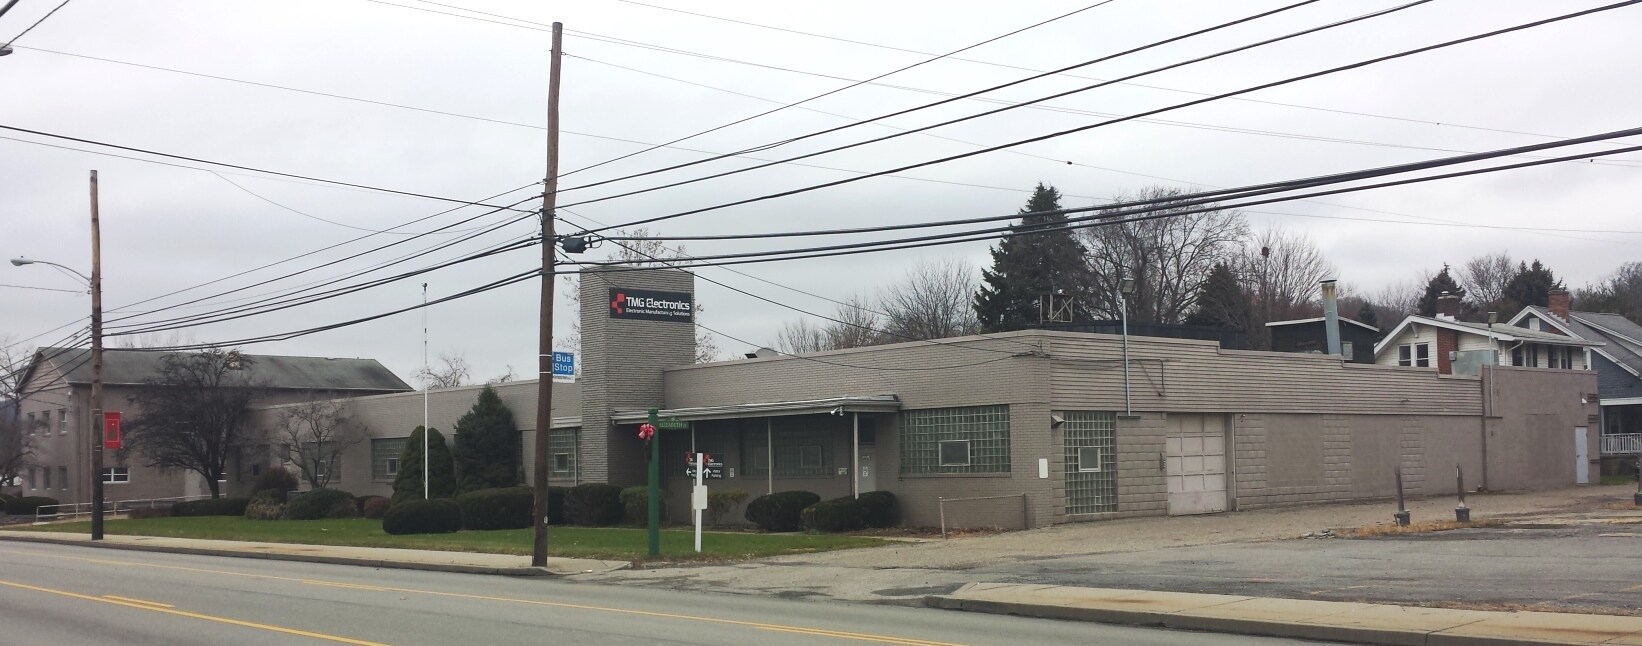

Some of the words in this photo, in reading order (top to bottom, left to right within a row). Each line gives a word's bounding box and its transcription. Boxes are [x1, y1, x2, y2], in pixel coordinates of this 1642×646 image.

[626, 296, 644, 308] TMG
[646, 298, 690, 310] Electronics
[556, 354, 571, 363] Bus
[554, 363, 573, 373] Stop
